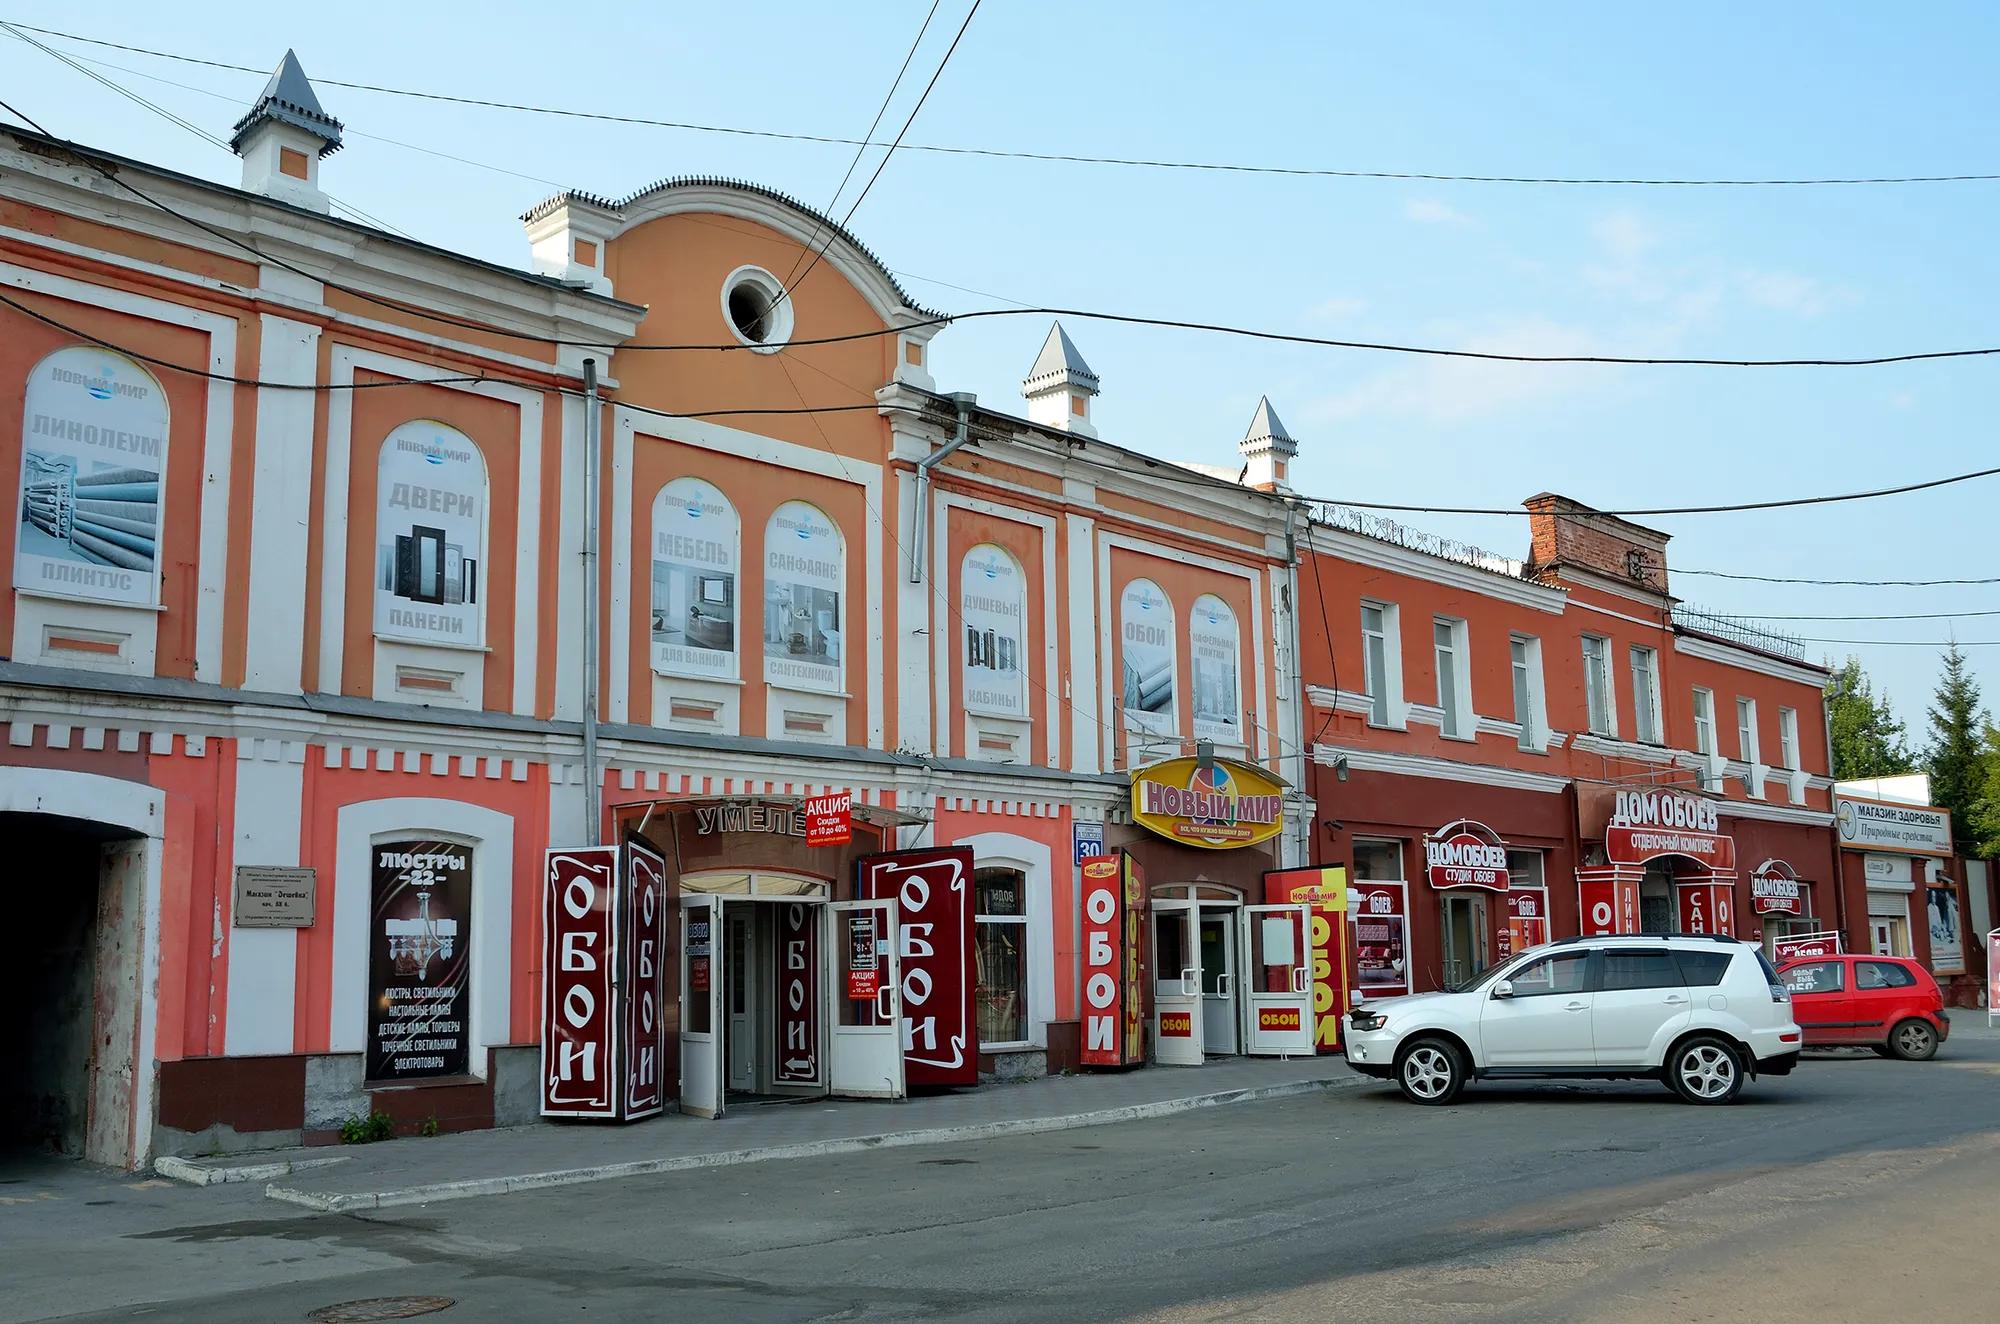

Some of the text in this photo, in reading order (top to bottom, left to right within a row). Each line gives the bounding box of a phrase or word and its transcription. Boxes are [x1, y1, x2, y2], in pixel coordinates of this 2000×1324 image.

[112, 383, 148, 400] МИР
[32, 414, 161, 458] ЛИНОЛЕУМ
[443, 451, 471, 464] МИР
[388, 482, 474, 518] ДВЕРИ
[702, 504, 724, 517] МИР
[811, 525, 830, 538] МИР
[658, 531, 728, 566] МЕБЕЛЬ
[769, 552, 837, 580] САНФАЯНС
[42, 562, 132, 592] ПЛИНТУС
[964, 594, 1018, 617] ДУШЕВЫЕ
[389, 608, 463, 634] ПАНЕЛИ
[1125, 622, 1166, 647] ОБОИ
[661, 648, 726, 668] ДЛЯ ВАННОЙ
[769, 661, 834, 683] САНТЕХНИКА
[968, 689, 1016, 708] КАБИНЫ
[807, 796, 850, 817] АКЦИЯ
[1140, 780, 1282, 824] НОВЫЙ МИР
[1614, 791, 1718, 831] ДОМ ОБОЕВ
[695, 806, 806, 837] УМЕЛЕ
[817, 817, 840, 826] Скидки
[1858, 806, 1940, 825] МАГАЗИН ЗДОРОВЬЯ
[818, 827, 825, 836] 10
[825, 828, 834, 836] до
[834, 825, 847, 833] 40%
[1861, 823, 1933, 843] Природные средства
[1080, 842, 1100, 857] 30
[1631, 833, 1715, 854] ОТДЕЛОЧНЫЙ КОМПЛЕКС
[380, 852, 465, 870] ЛЮСТРЫ
[1428, 842, 1507, 868] ДОМ ОБОЕВ
[1445, 869, 1496, 883] СТУДИЯ ОБОЕВ
[1321, 892, 1337, 900] МИР
[1754, 878, 1798, 897] ДОМ ОБОЕВ
[1370, 896, 1392, 914] ОБОЕВ
[1519, 901, 1536, 916] ОБОЕВ
[1782, 945, 1798, 955] дом
[899, 874, 936, 1052] ОБОИ
[1086, 888, 1116, 1051] ОБОИ
[559, 875, 597, 1082] ОБОИ
[788, 904, 806, 1050] ОБОИ
[852, 972, 875, 980] АКЦИЯ
[1311, 915, 1337, 1046] ОБОИ
[384, 987, 456, 1000] ЛЮСТРЫ, СВЕТИЛЬНИКИ
[639, 888, 655, 1087] ОБОИ
[389, 1004, 451, 1017] НАСТОЛЬНЫЕ ЛАМПЫ
[1261, 1013, 1299, 1025] ОБОИ
[378, 1022, 406, 1037] ДЕТСКИЕ
[432, 1021, 460, 1033] ТОРШЕРЫ
[1161, 1019, 1191, 1031] ОБОИ
[382, 1038, 457, 1053] ТОЧЕЧНЫЕ СВЕТИЛЬНИКИ
[394, 1056, 444, 1070] ЭЛЕКТРОТОВАРЫ
